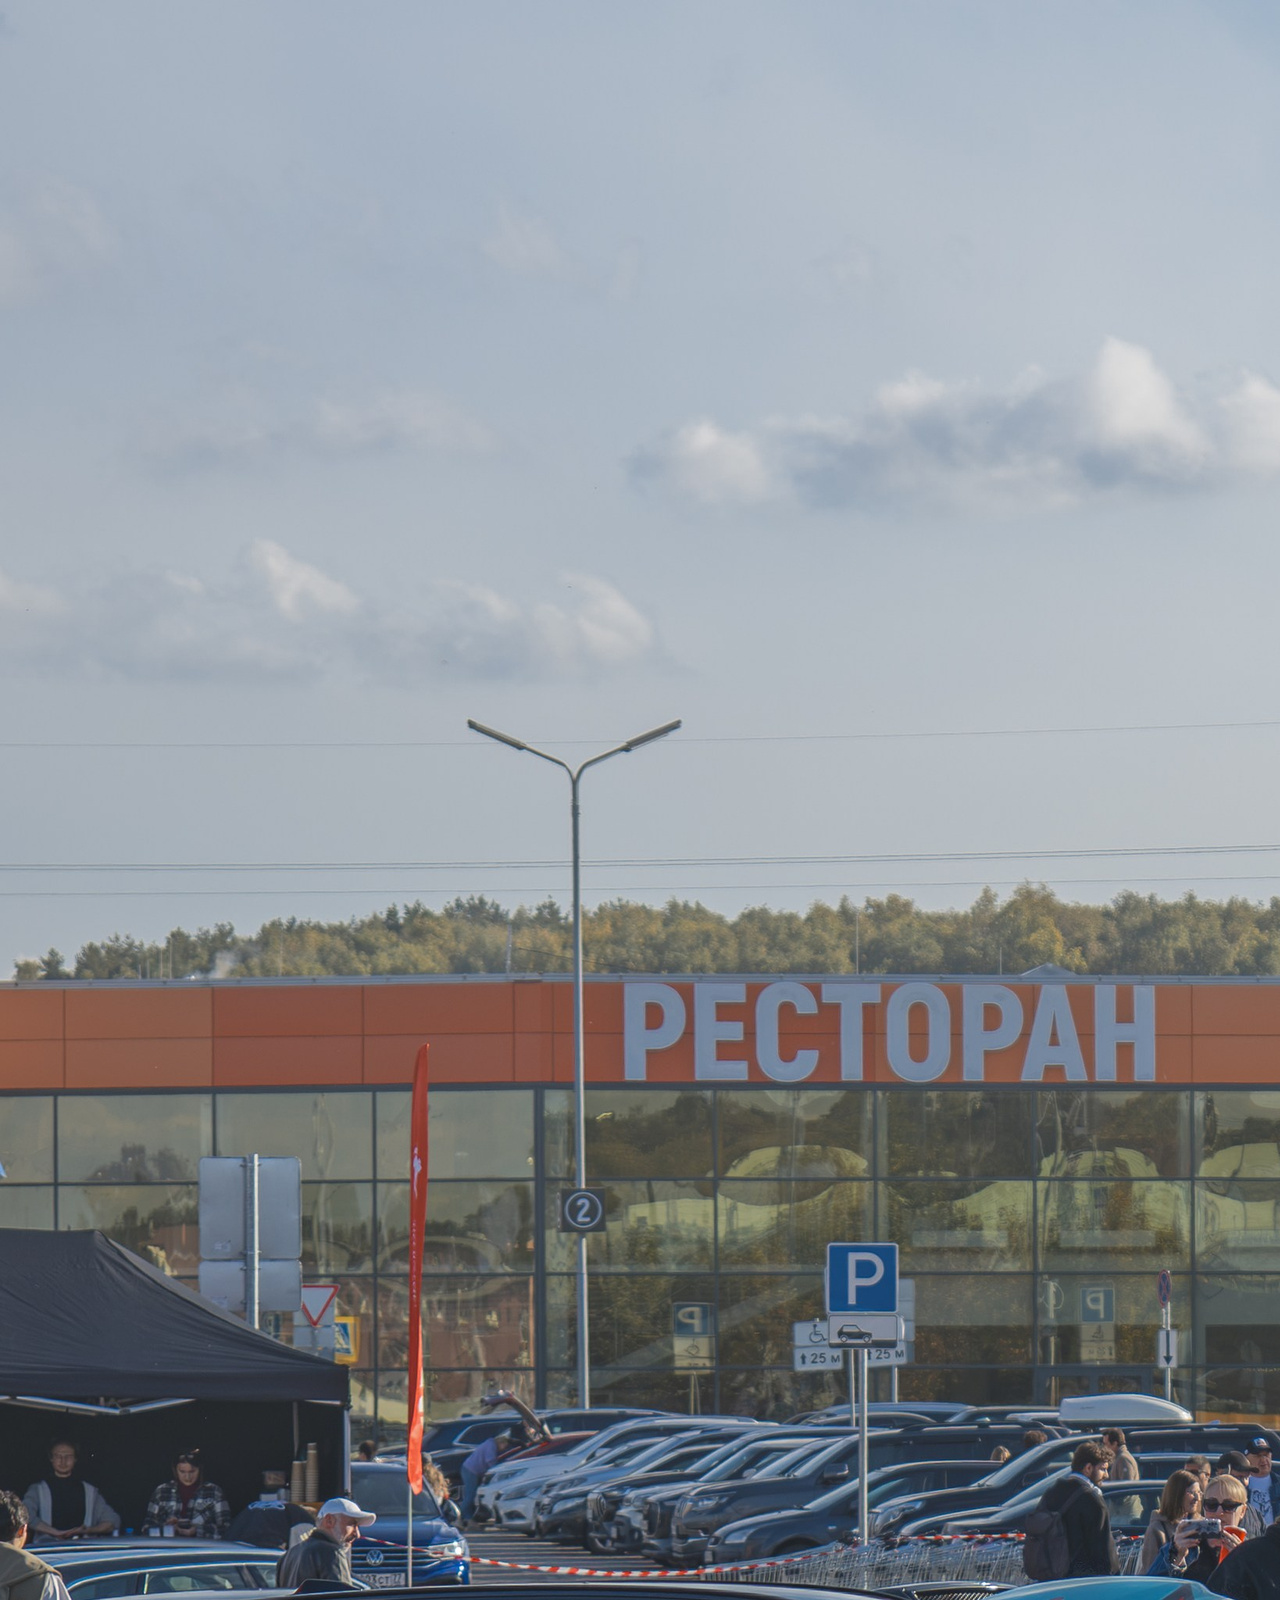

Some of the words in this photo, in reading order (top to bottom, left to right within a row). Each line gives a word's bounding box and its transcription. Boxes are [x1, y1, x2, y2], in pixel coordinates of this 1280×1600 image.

[624, 982, 1155, 1082] РЕСТОРАН
[577, 1198, 590, 1221] 2
[848, 1252, 884, 1305] P
[811, 1352, 827, 1364] 25
[876, 1348, 891, 1360] 25
